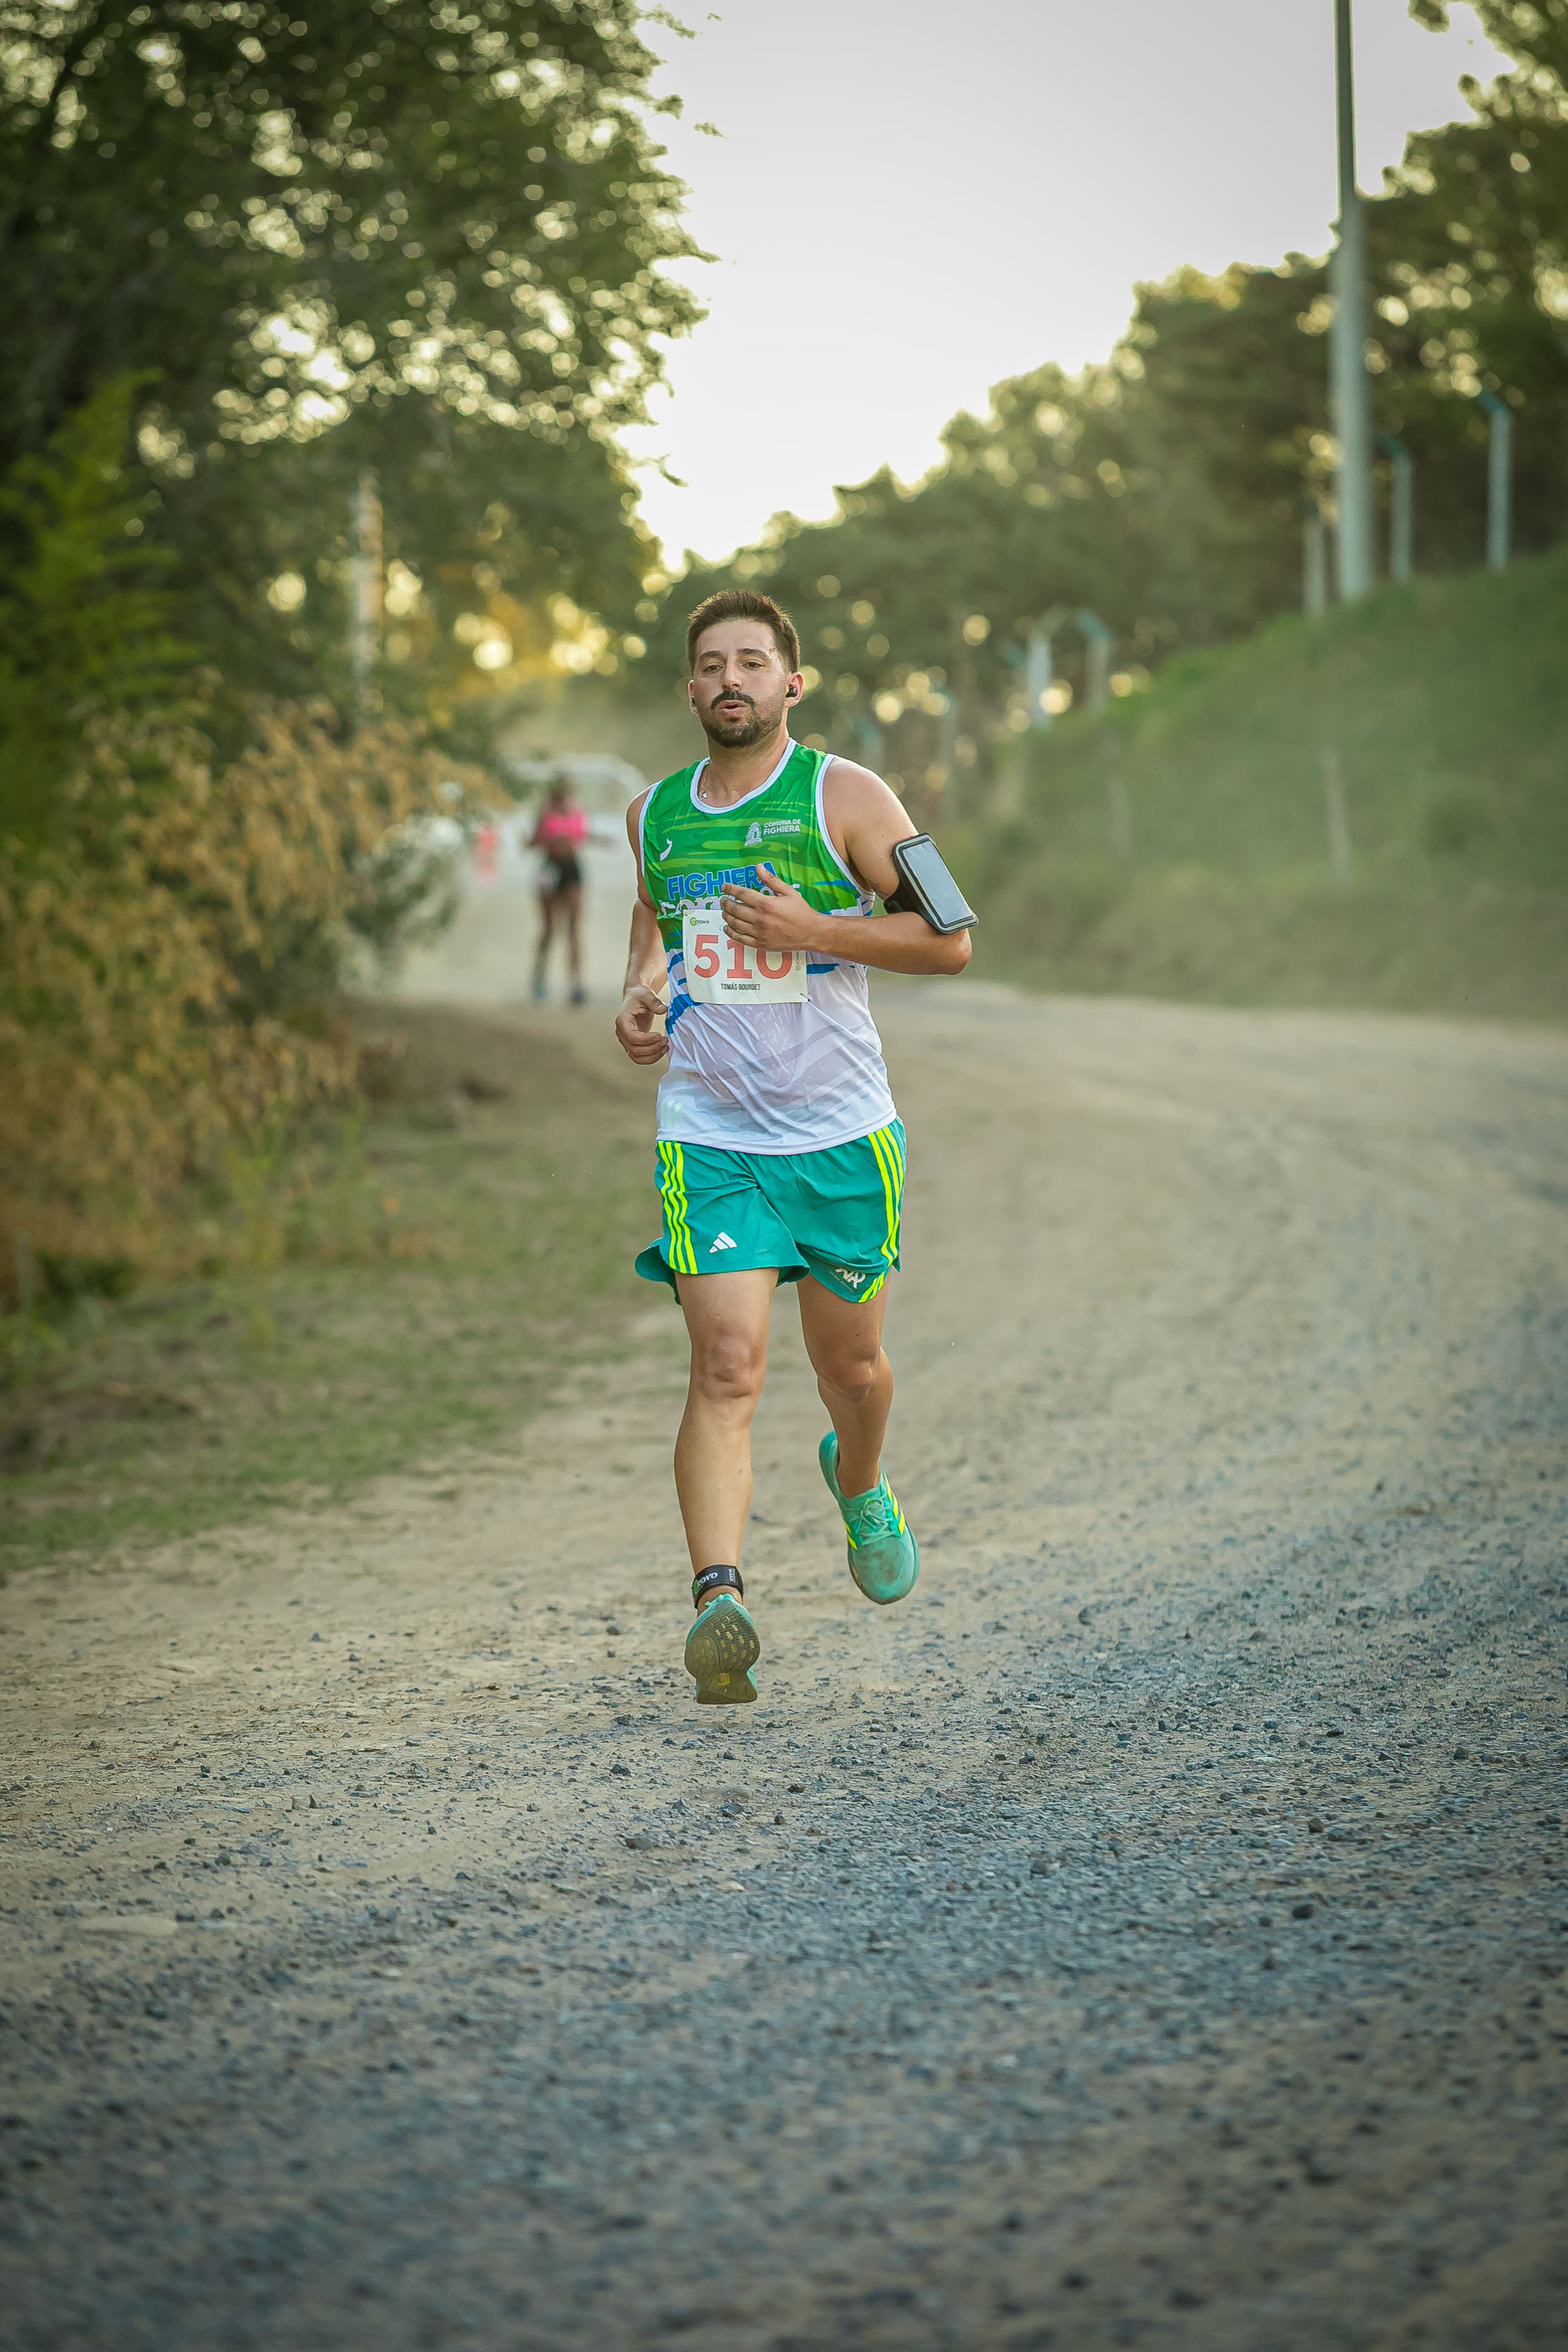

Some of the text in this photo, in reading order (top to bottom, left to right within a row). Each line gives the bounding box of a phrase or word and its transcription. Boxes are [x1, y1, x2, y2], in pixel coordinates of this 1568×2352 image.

[763, 820, 791, 828] COMUNA
[763, 825, 801, 836] FIGHIERA
[720, 982, 738, 991] TOMÁS
